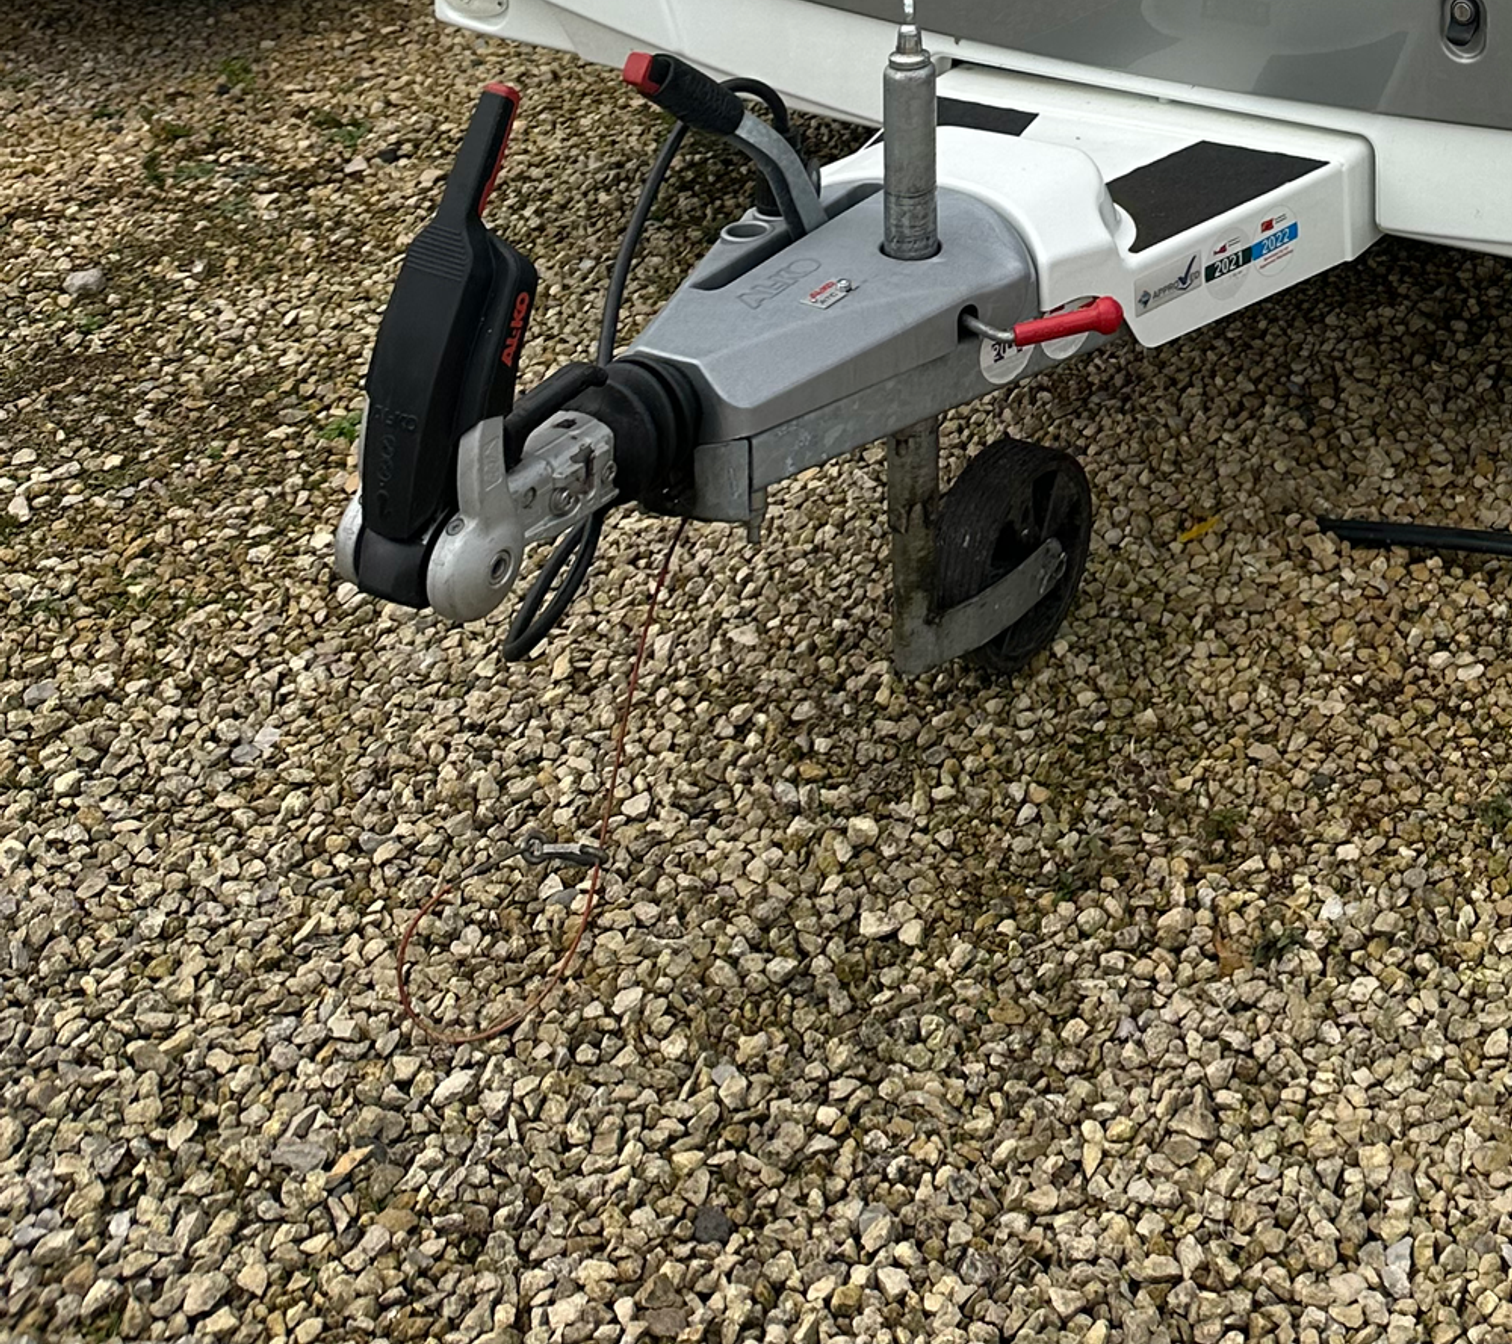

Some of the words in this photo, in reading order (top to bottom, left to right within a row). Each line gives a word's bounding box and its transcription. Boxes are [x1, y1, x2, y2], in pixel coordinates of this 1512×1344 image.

[1261, 228, 1291, 255] 2022
[1213, 252, 1244, 278] 2021
[501, 291, 530, 368] AL-KO
